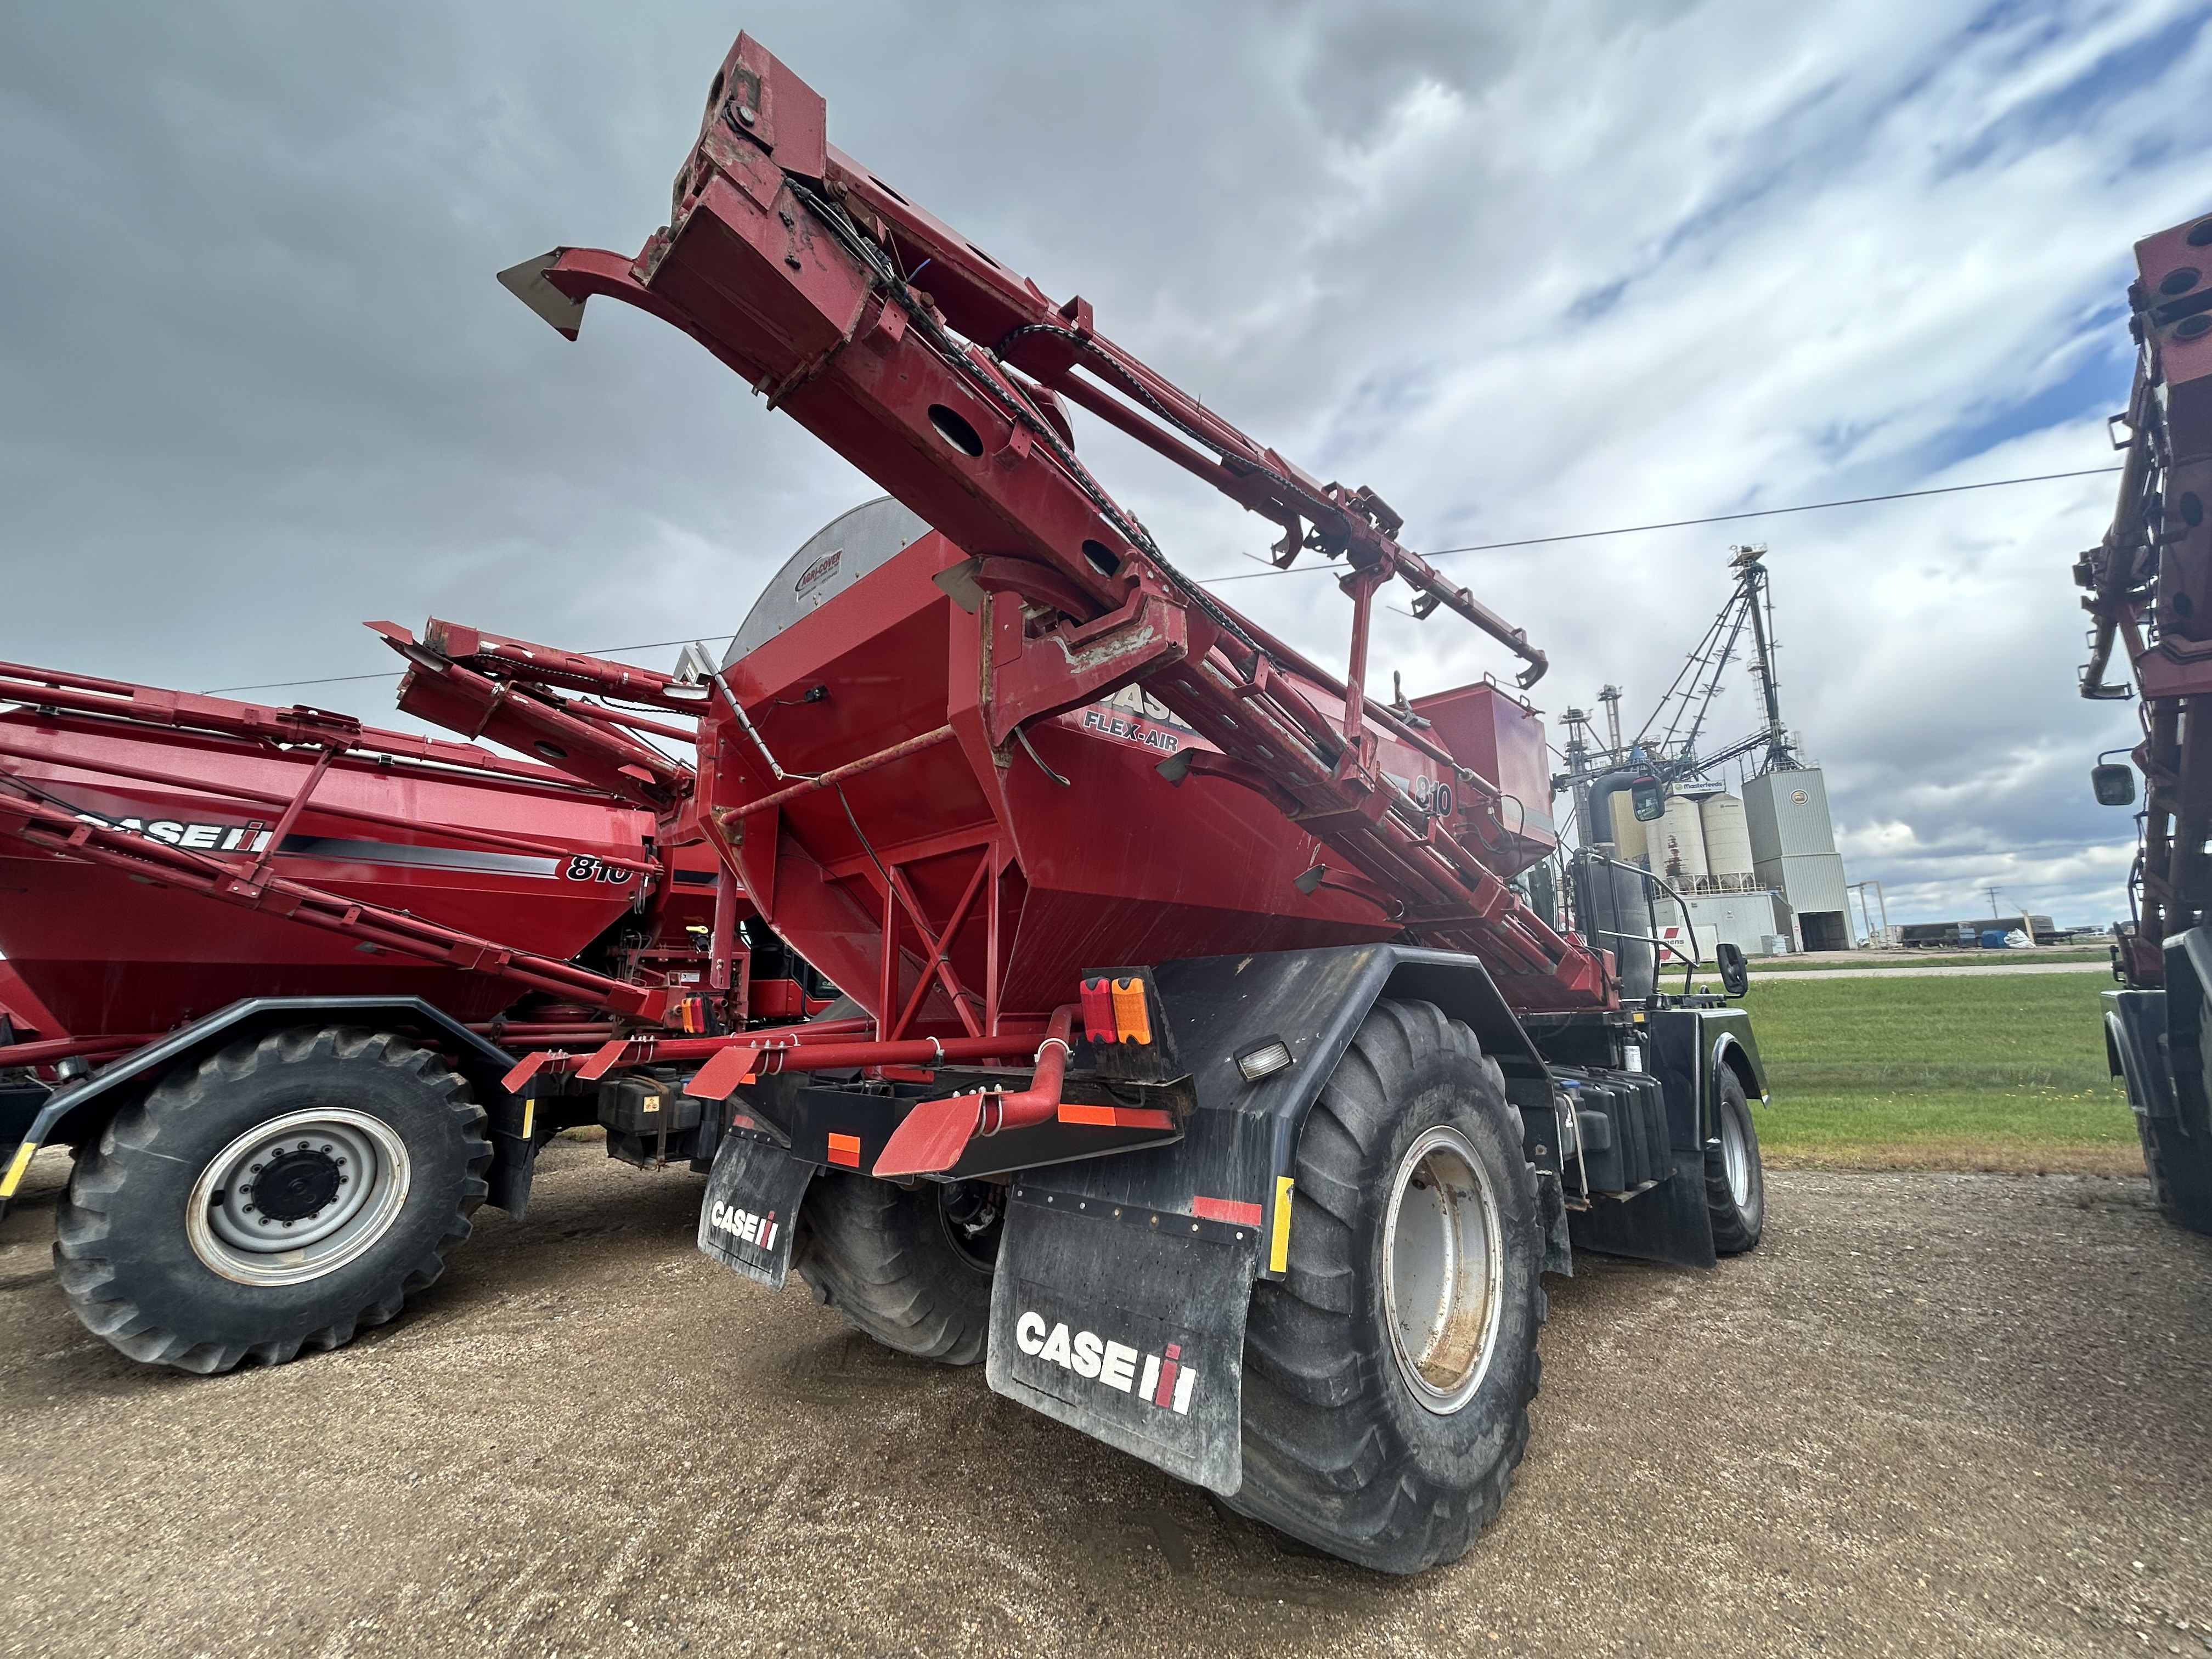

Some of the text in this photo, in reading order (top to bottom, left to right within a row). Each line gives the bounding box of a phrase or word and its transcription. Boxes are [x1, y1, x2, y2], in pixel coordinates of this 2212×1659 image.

[802, 551, 842, 585] AGRI-COVER
[1100, 682, 1192, 730] AS
[1083, 711, 1178, 753] FLEX-AIR
[1415, 775, 1453, 817] 810
[712, 1200, 759, 1243] CASE
[1016, 1311, 1138, 1393] CASE
